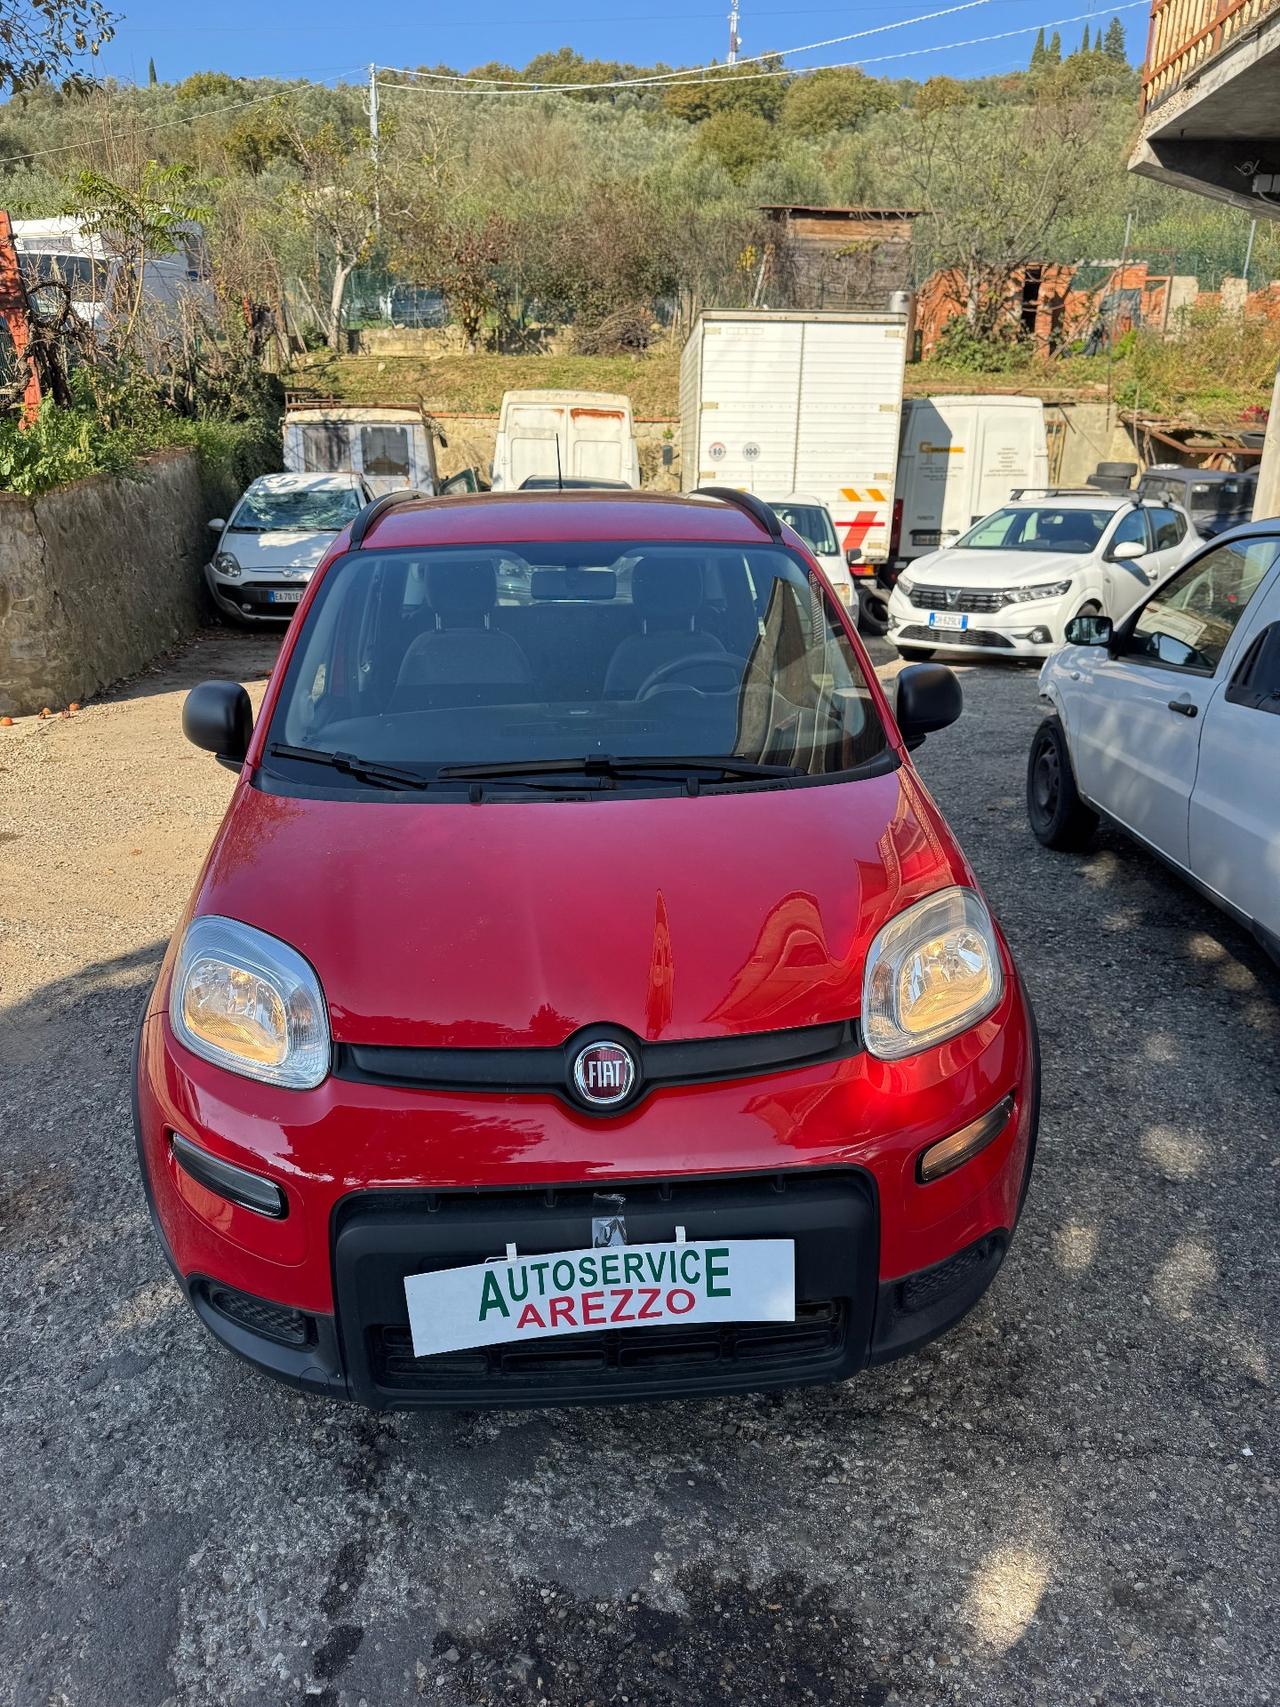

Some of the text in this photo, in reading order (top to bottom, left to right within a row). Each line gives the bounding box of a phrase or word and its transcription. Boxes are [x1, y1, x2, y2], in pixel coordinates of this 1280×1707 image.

[588, 1061, 623, 1087] FIAT
[478, 1247, 732, 1321] AUTOSERVICE
[516, 1288, 696, 1329] AREZZO
